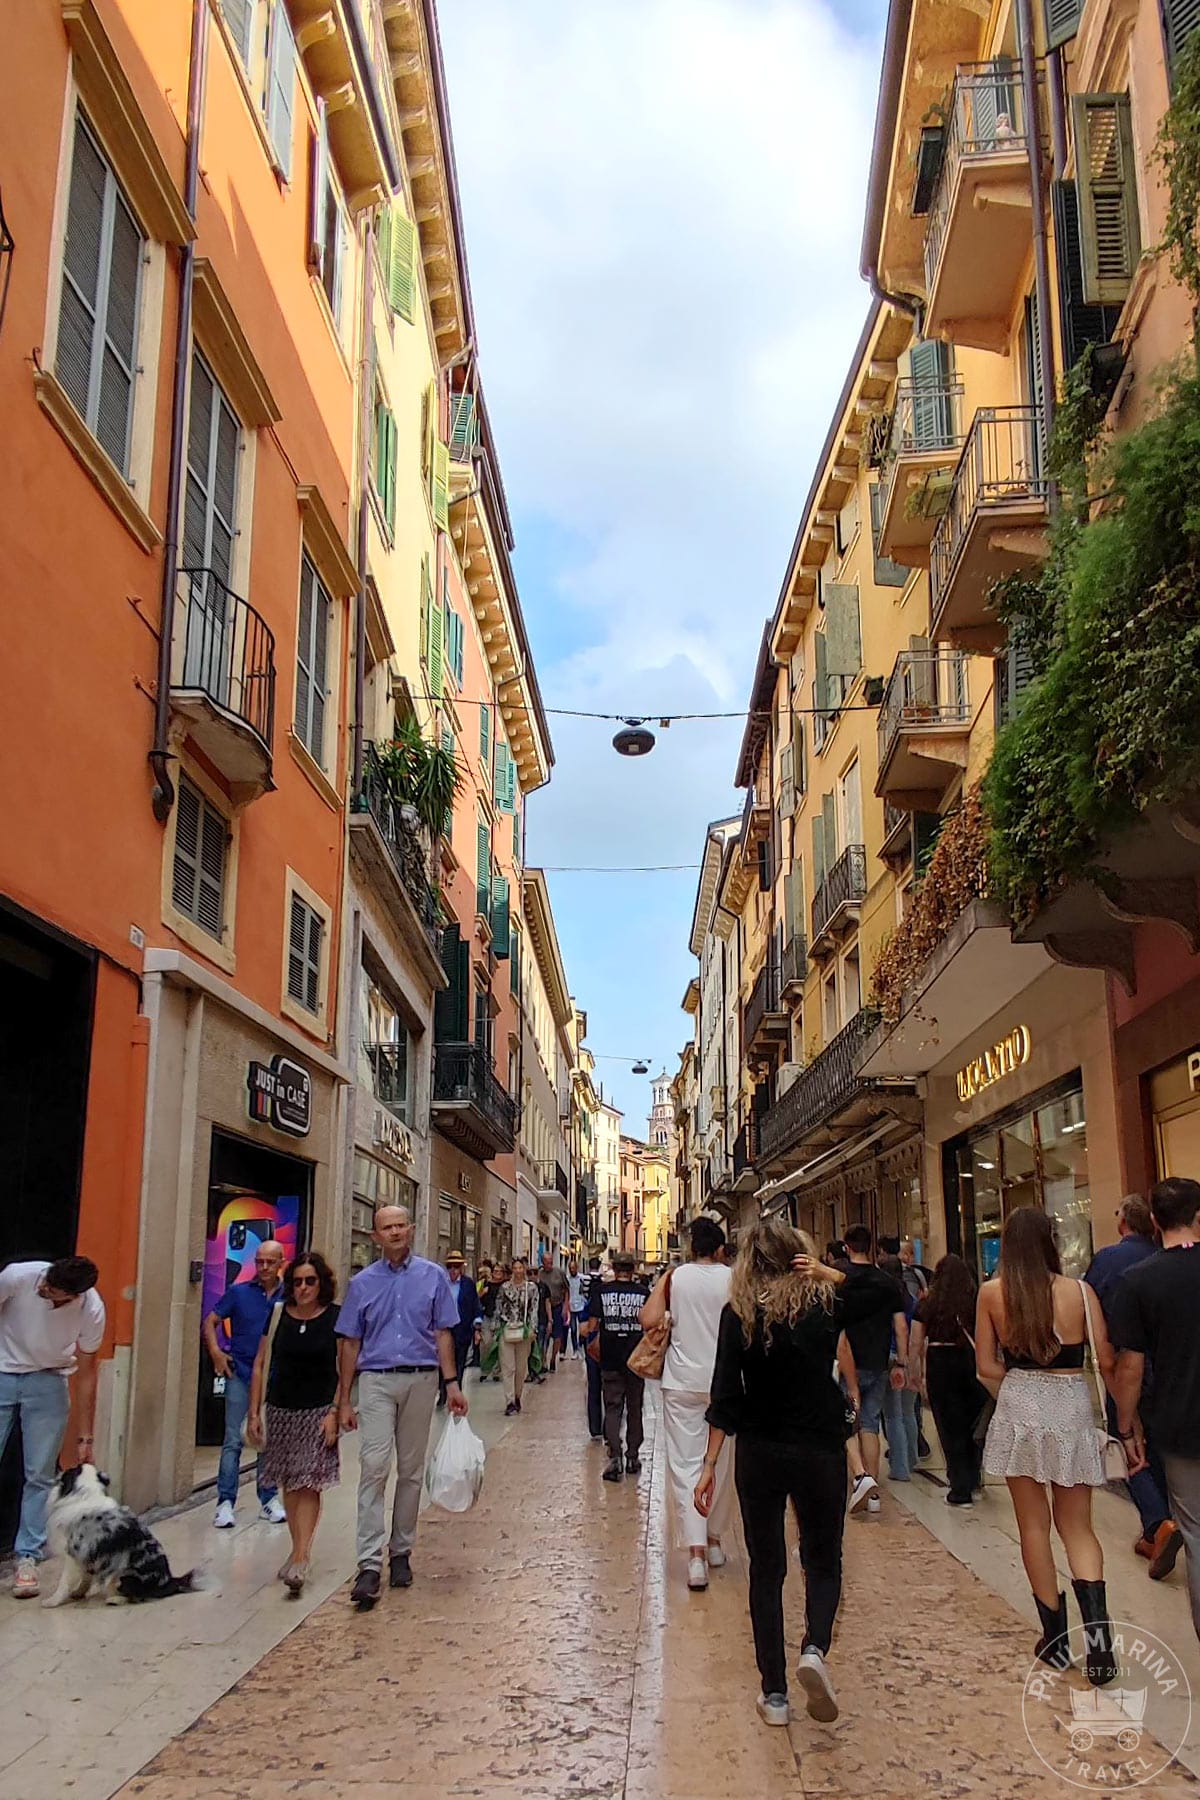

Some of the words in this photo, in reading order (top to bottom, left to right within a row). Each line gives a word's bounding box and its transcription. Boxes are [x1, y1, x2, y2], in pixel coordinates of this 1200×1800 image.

[255, 1068, 276, 1094] JUST
[276, 1078, 286, 1099] in
[287, 1085, 306, 1109] CASE
[600, 1292, 646, 1307] WELCOME
